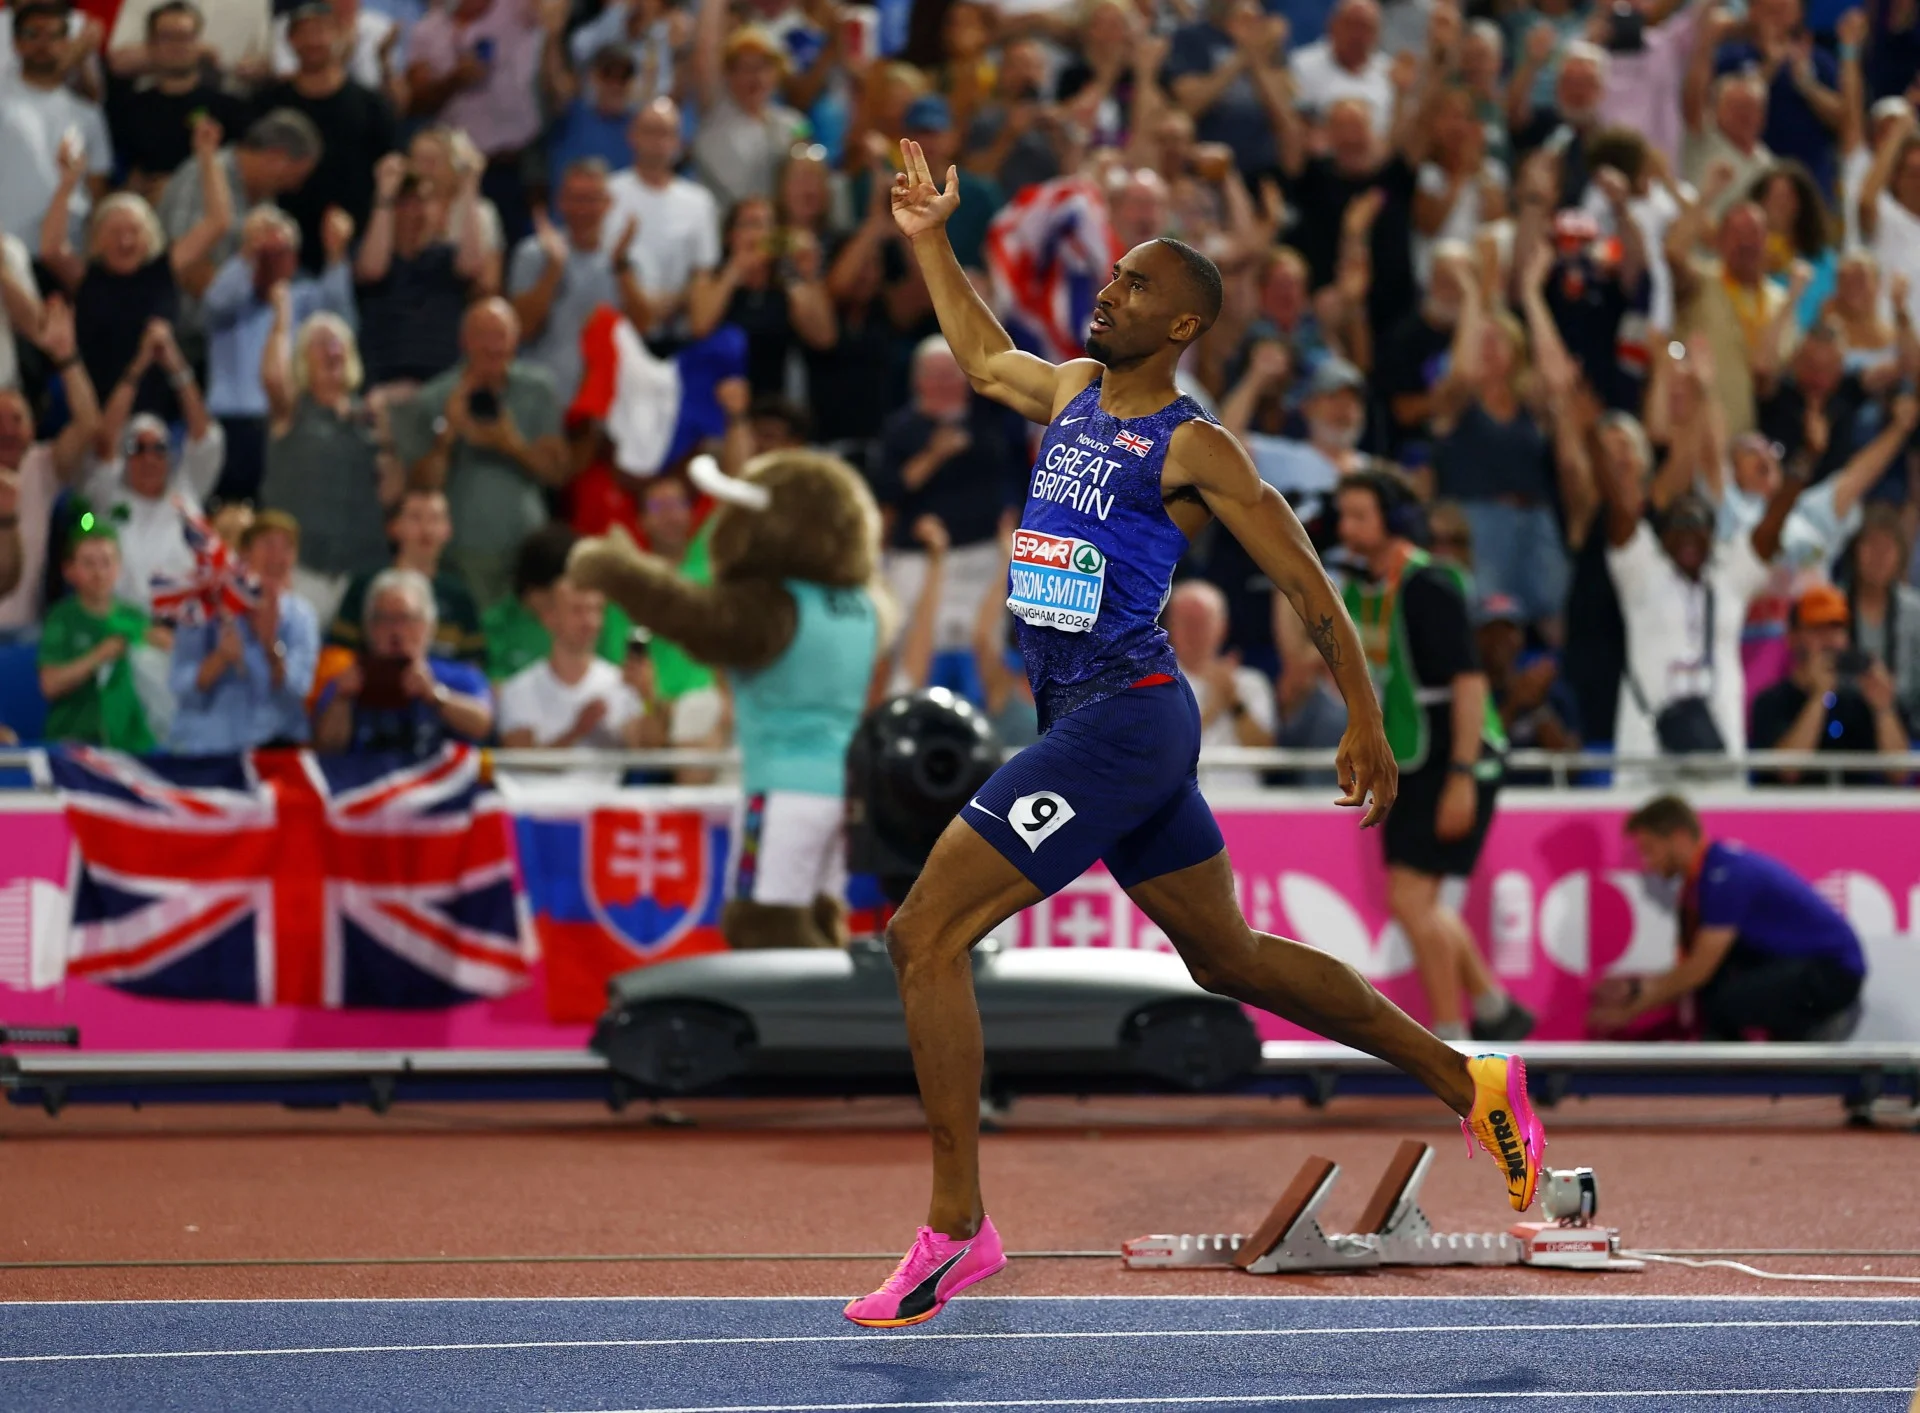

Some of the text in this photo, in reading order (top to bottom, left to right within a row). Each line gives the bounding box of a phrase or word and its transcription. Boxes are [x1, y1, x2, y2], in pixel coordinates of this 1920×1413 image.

[1075, 432, 1110, 454] Novuna
[1045, 443, 1122, 488] GREAT
[1032, 469, 1115, 521] BRITAIN
[1014, 536, 1070, 565] SPAR
[1008, 602, 1091, 628] BRNGHAM 2026
[1021, 797, 1058, 832] 9
[1488, 1109, 1527, 1186] NITRO
